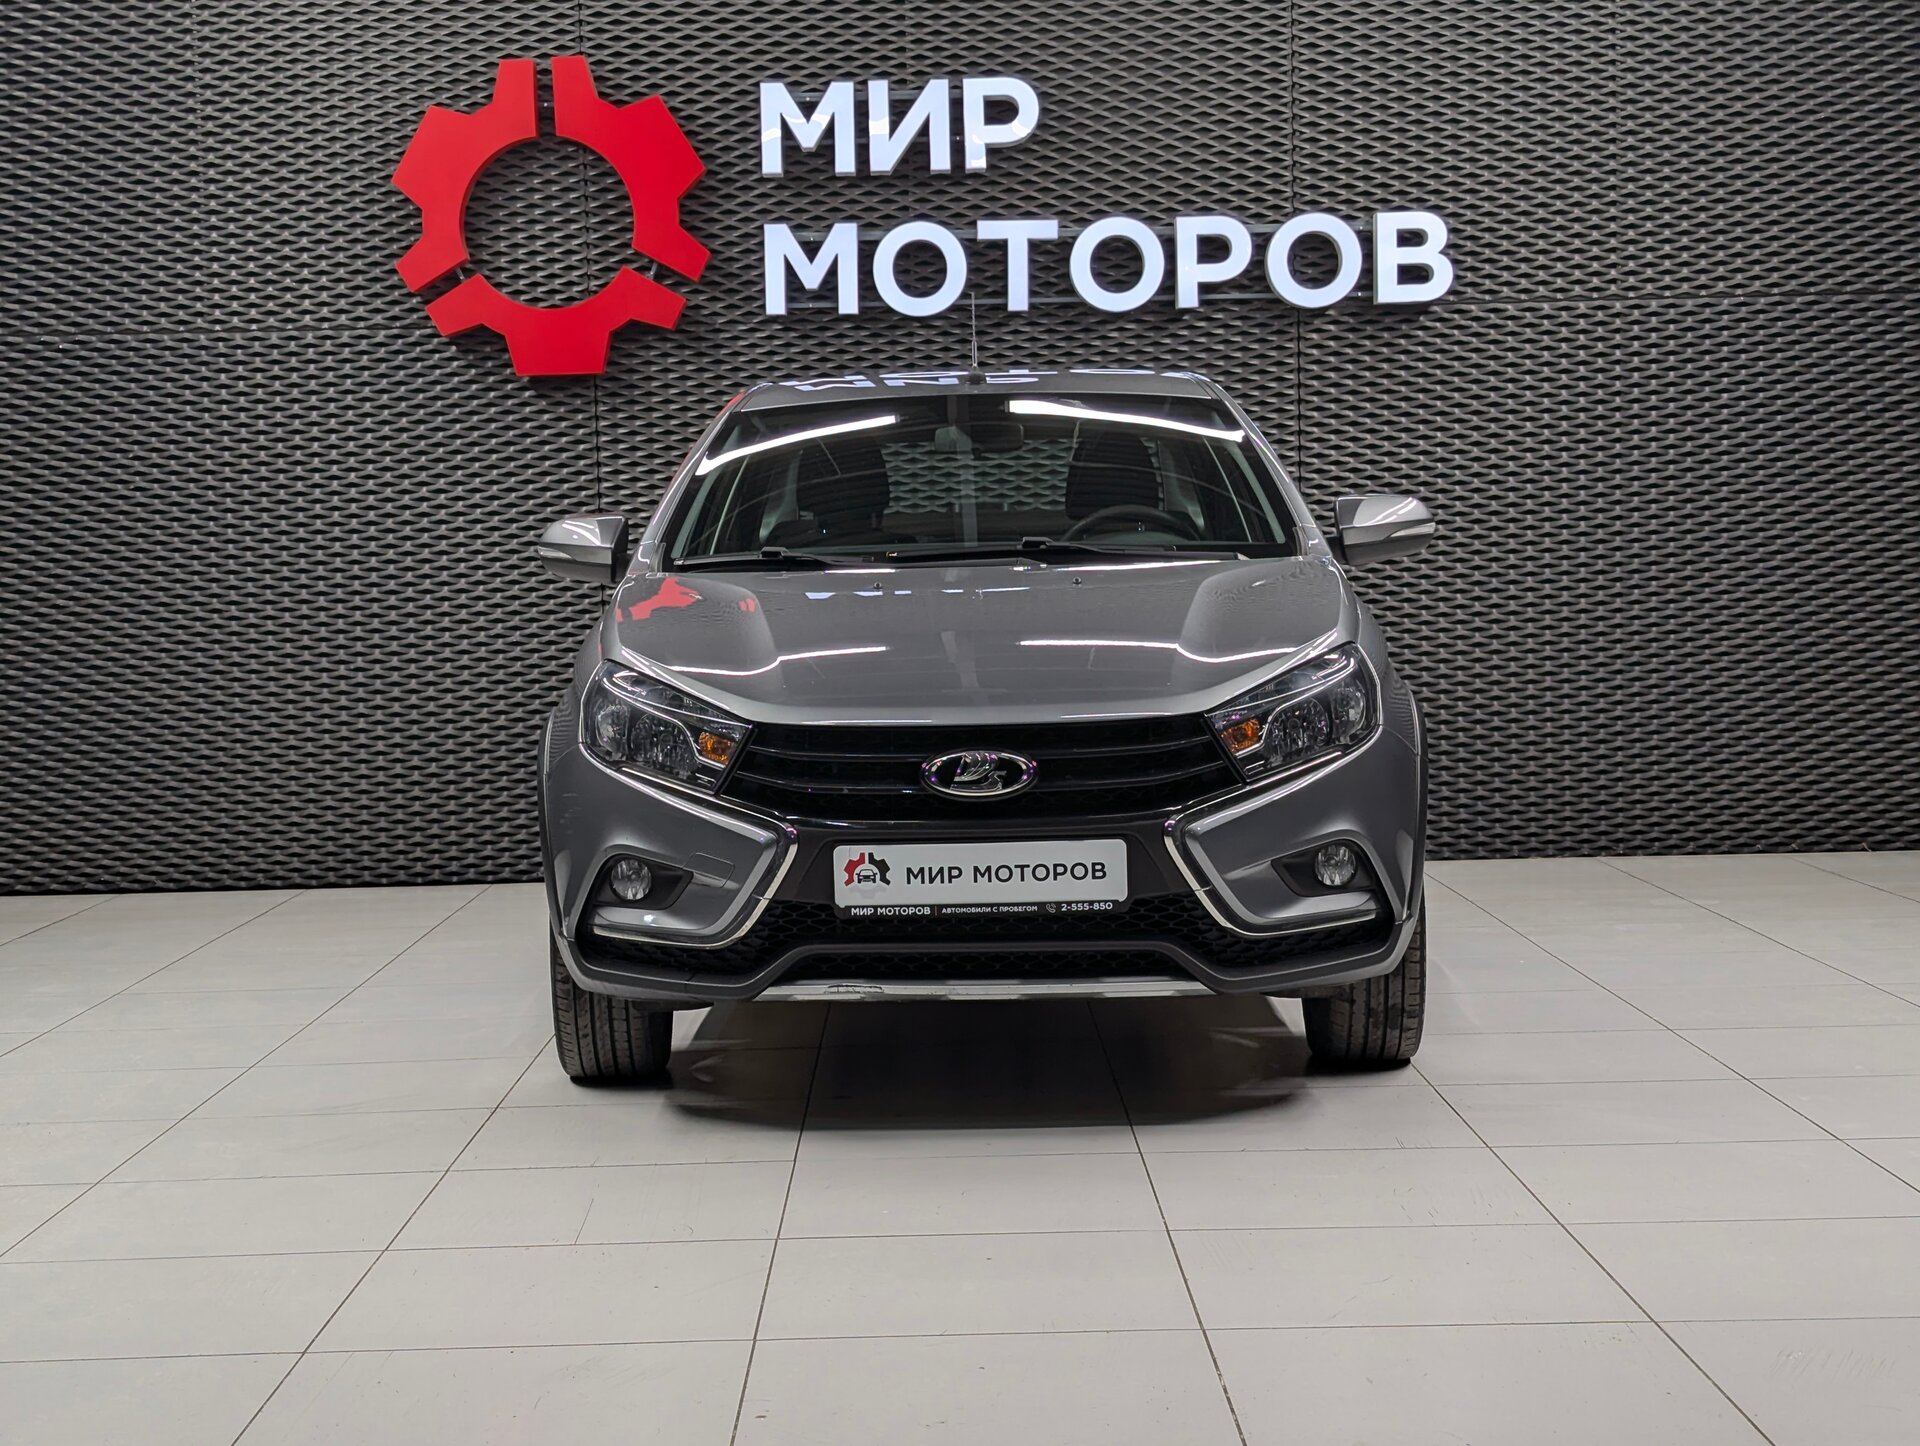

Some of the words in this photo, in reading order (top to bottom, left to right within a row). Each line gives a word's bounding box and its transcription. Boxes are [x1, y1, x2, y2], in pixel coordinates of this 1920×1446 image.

[760, 77, 1039, 177] МИР
[763, 211, 1454, 316] МОТОРОВ
[905, 866, 963, 885] МИР
[973, 861, 1107, 884] МОТОРОВ
[851, 907, 874, 916] МИР
[877, 906, 931, 916] МОТОРОВ
[941, 906, 991, 914] АВТОМОБИЛИ
[999, 905, 1038, 913] ПРОБЕГОМ
[1061, 902, 1113, 911] 2-555-850
